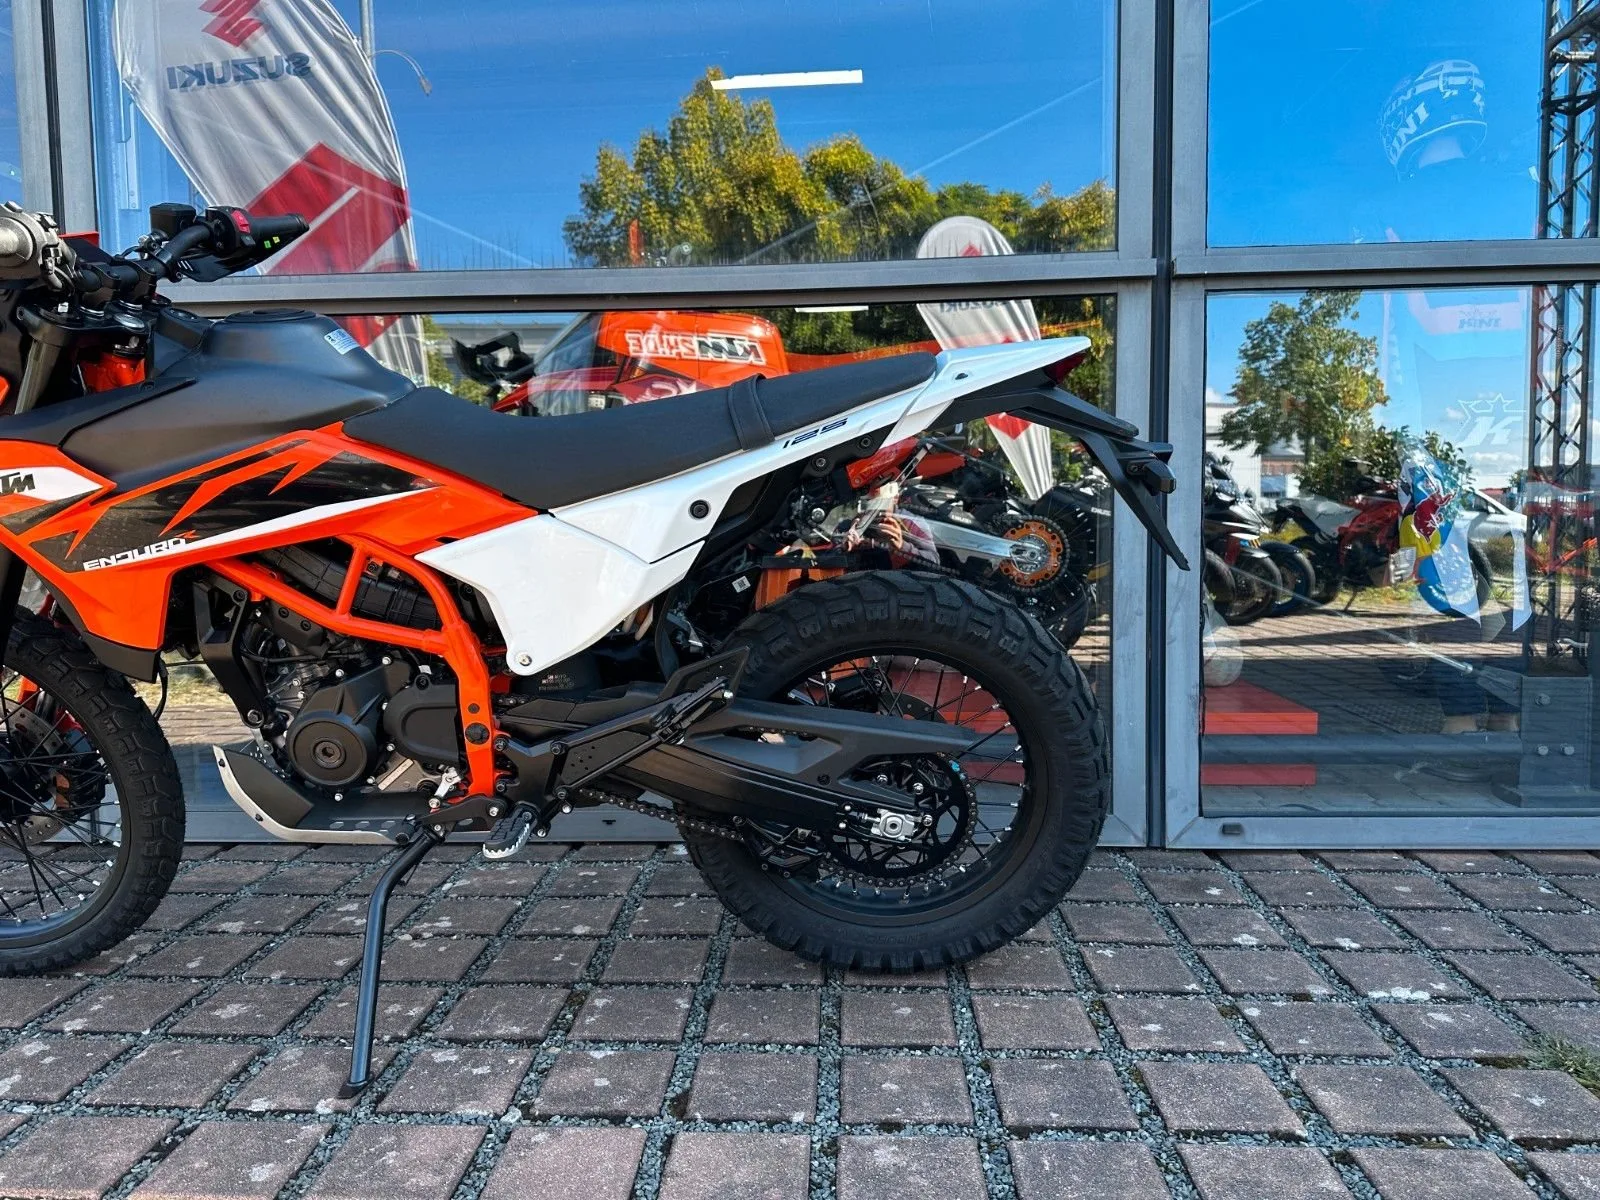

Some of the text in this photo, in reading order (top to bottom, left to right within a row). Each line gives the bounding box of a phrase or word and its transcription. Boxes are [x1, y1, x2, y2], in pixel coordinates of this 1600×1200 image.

[782, 417, 849, 449] 125
[0, 471, 36, 494] TM
[82, 537, 187, 572] ENDURO
